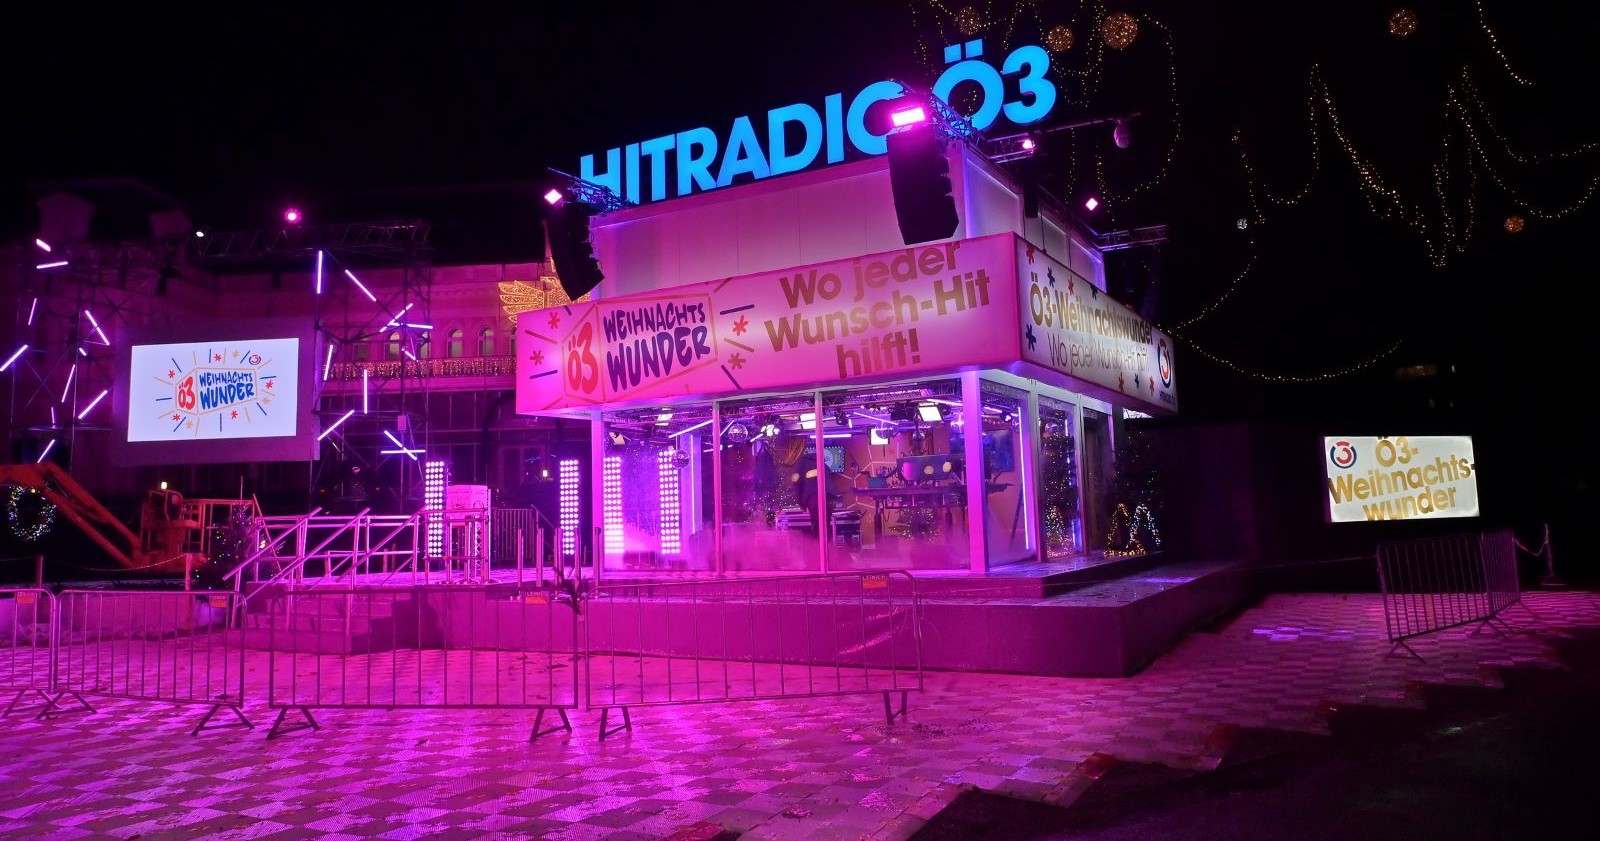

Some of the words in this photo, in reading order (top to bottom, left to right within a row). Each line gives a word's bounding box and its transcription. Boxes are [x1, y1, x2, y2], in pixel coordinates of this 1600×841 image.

[580, 80, 905, 205] HITRADIO
[931, 39, 1057, 132] Ö3
[779, 270, 842, 309] Wo
[852, 240, 961, 302] jeder
[602, 300, 705, 343] WEIHNACHTS
[764, 268, 992, 353] Wunsch-Hit
[199, 371, 253, 387] WEIHNACHTS
[567, 322, 599, 394] Ö3
[606, 325, 711, 392] WUNDER
[836, 328, 921, 379] hilft!
[178, 376, 196, 411] Ö3
[200, 382, 255, 410] WUNDER
[1375, 436, 1420, 467] Ö3-
[1328, 454, 1476, 505] Weihnachts-
[1362, 486, 1457, 521] wunder
